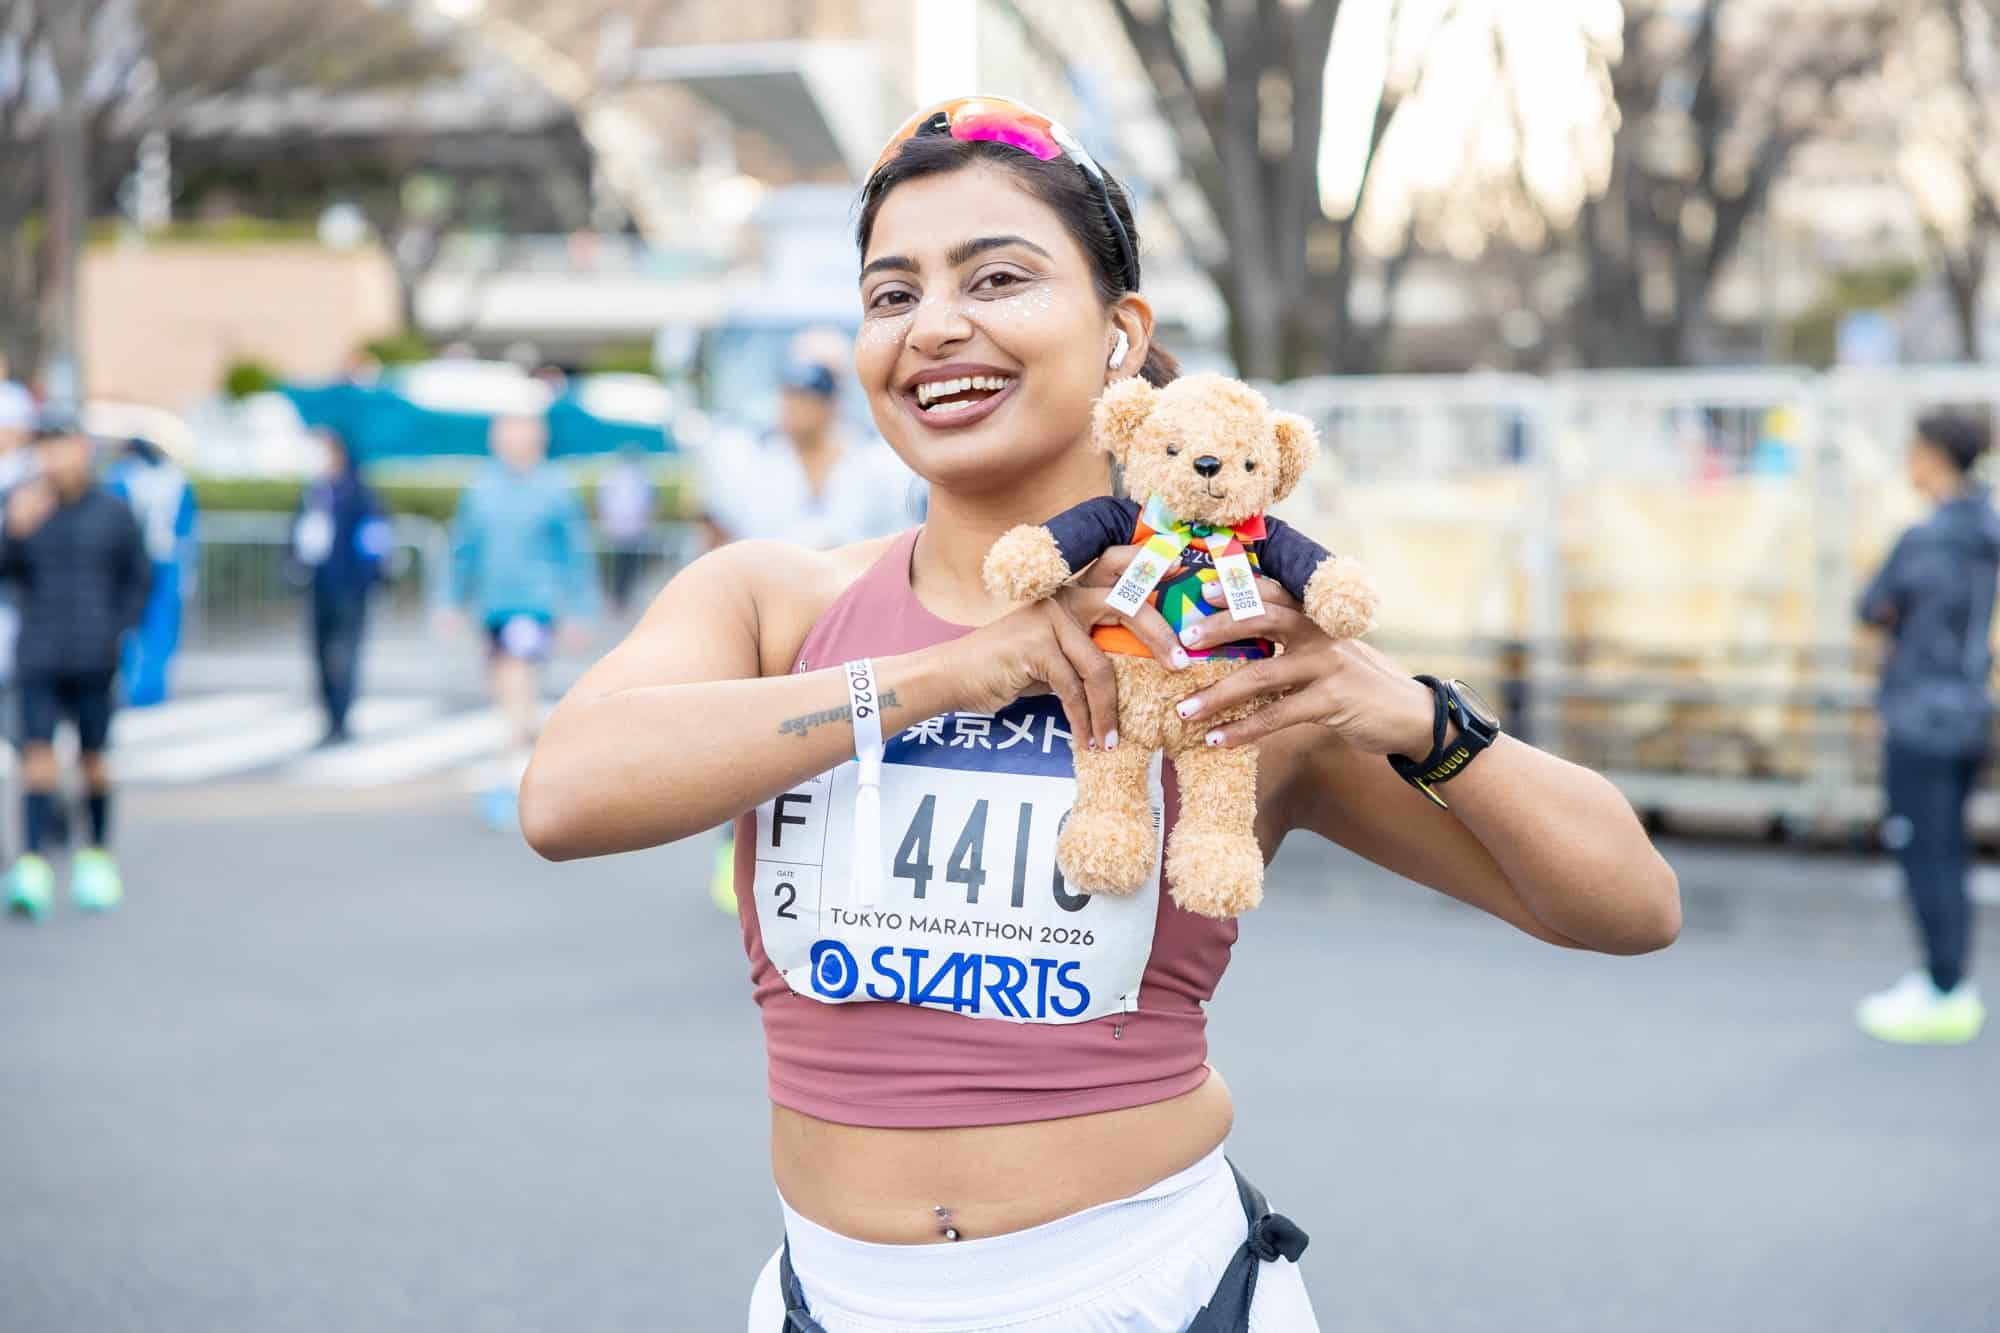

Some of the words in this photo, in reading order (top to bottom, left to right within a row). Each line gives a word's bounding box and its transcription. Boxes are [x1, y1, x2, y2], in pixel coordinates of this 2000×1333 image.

[1117, 590, 1139, 605] 2026
[1234, 599, 1258, 610] 2026
[850, 669, 875, 719] 2026
[771, 792, 813, 848] F
[776, 870, 795, 879] GATE
[774, 881, 798, 921] 2
[830, 907, 903, 930] TOKYO
[909, 916, 1033, 942] MARATHON
[1040, 926, 1095, 947] 2026
